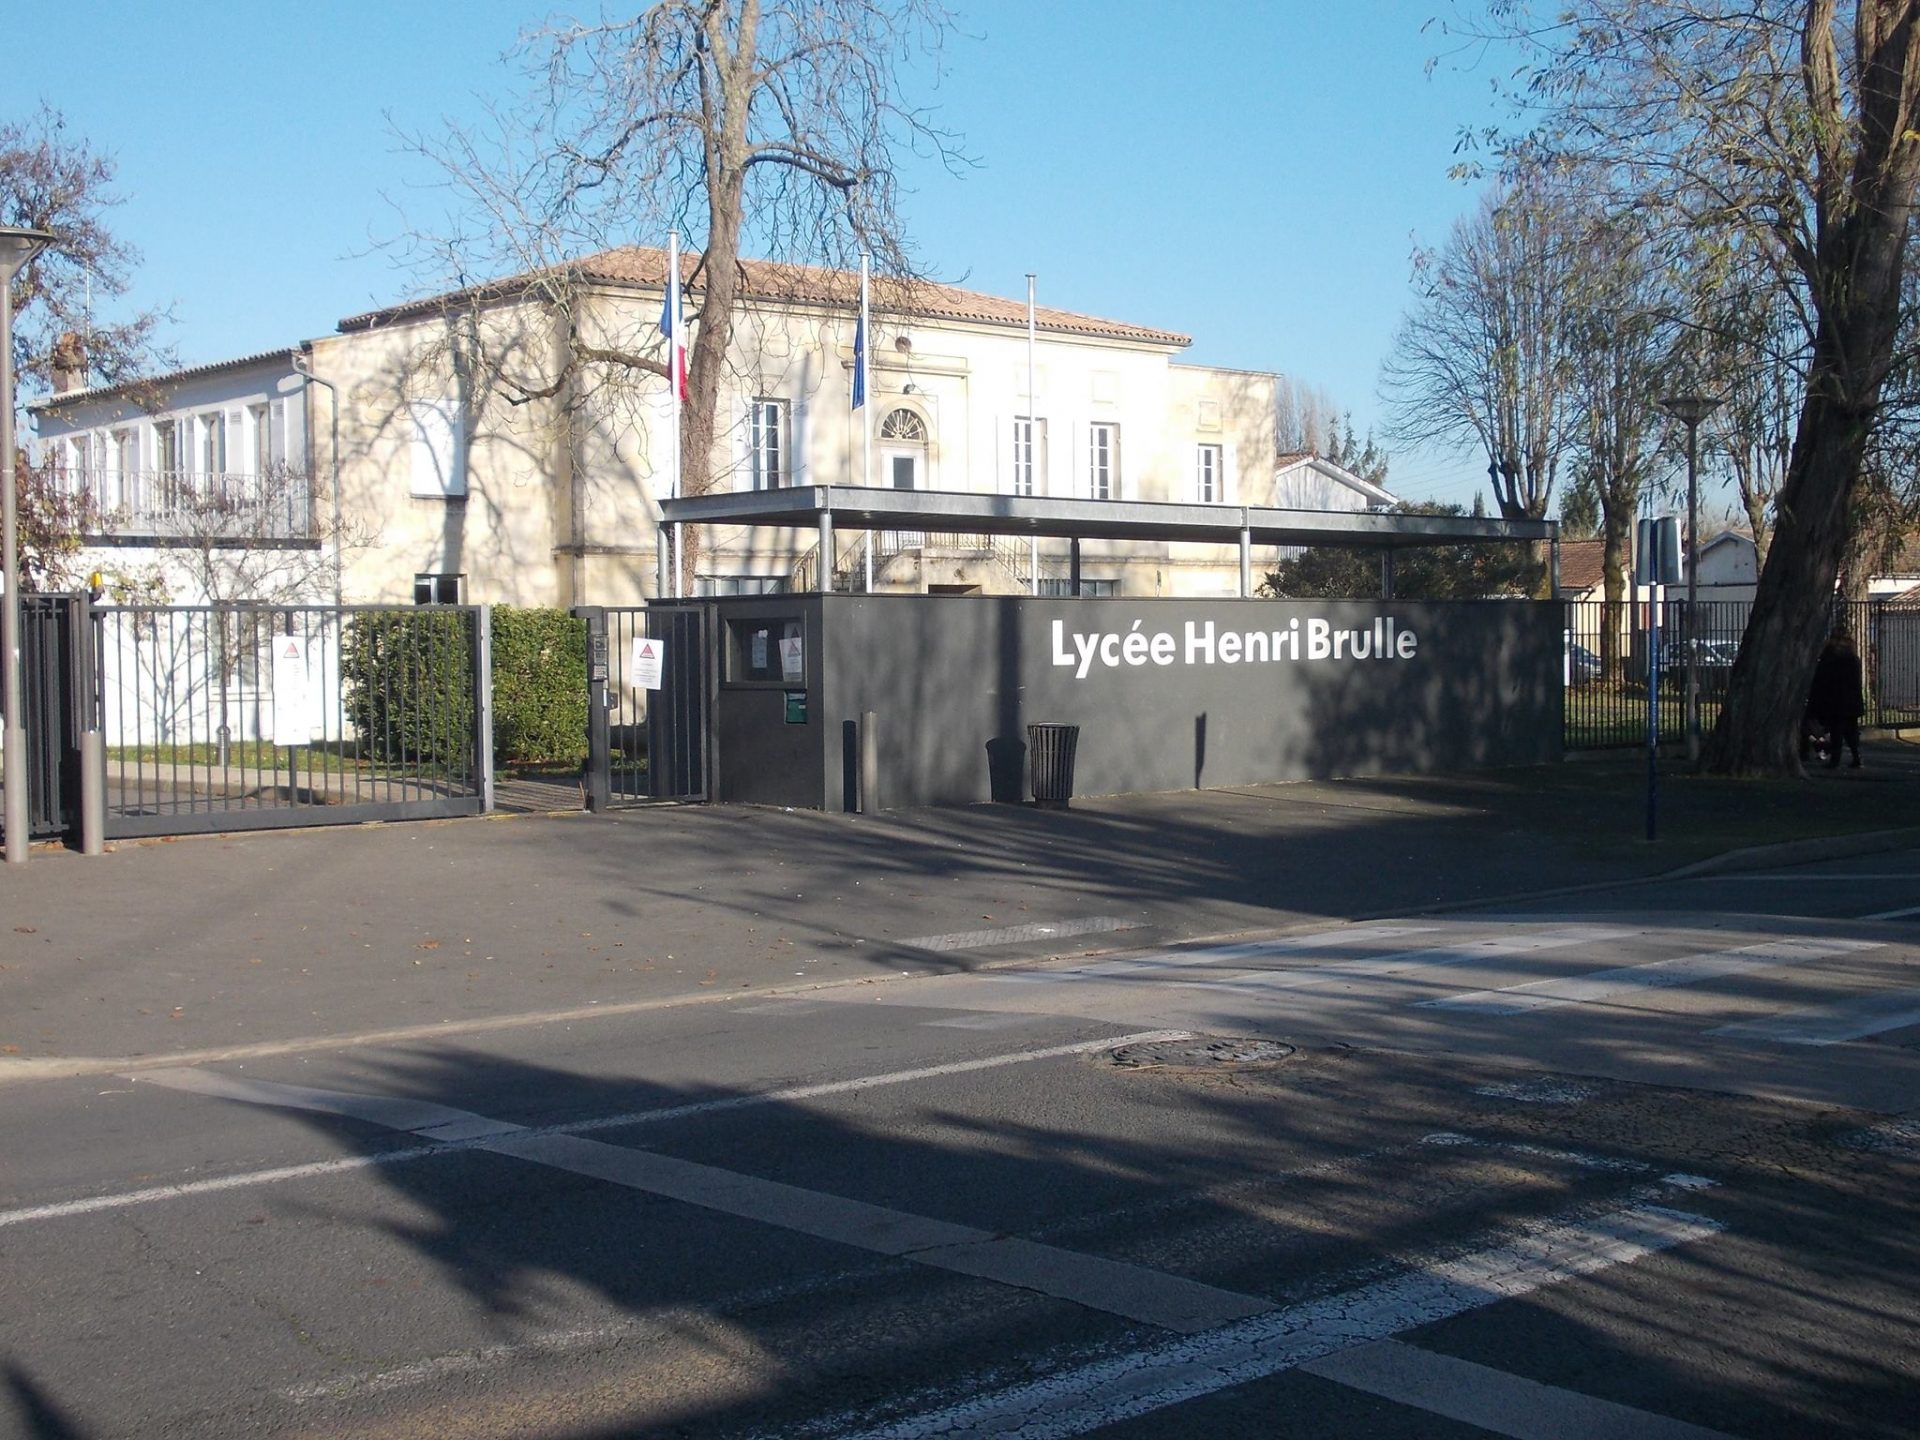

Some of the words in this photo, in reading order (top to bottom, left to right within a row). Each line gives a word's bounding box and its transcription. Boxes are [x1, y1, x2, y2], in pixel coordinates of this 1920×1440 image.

[1052, 619, 1176, 679] Lycée
[1184, 617, 1300, 665] Henri
[1307, 617, 1417, 660] Brulle
